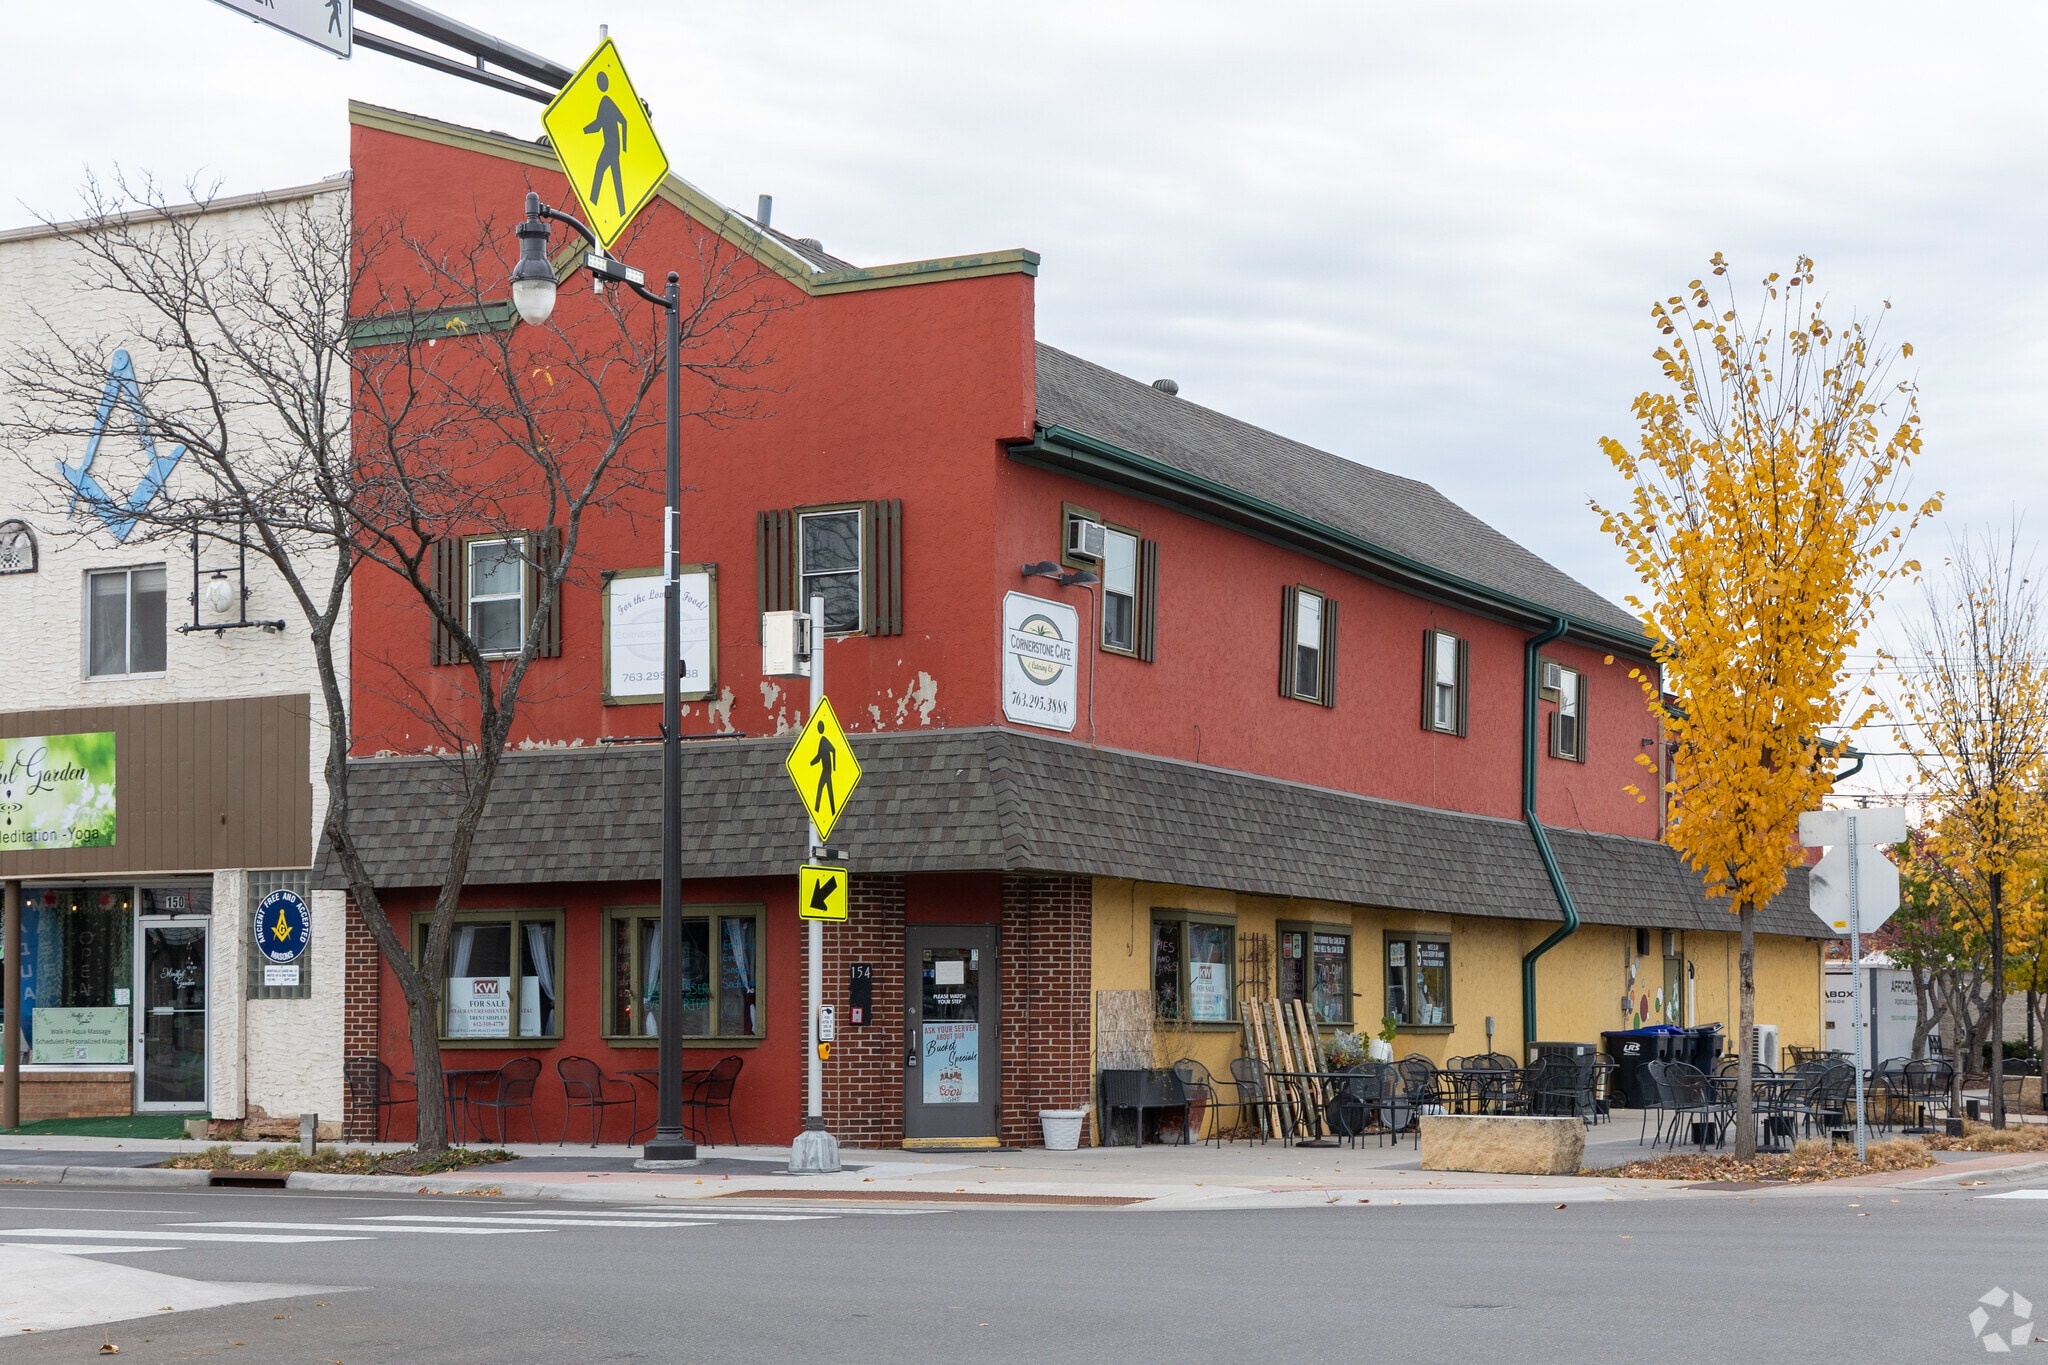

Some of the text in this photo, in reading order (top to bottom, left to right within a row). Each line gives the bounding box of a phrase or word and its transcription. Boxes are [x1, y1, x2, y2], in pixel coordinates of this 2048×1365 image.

[617, 589, 665, 615] For the Lov
[682, 592, 708, 611] Food!
[1011, 634, 1071, 661] CORNERSTONE CAFE
[1012, 691, 1068, 715] 763.295.3888
[16, 747, 88, 796] Garden
[0, 829, 57, 843] editation
[167, 896, 184, 908] 150
[257, 892, 309, 943] ANCIENT FREE AND ACCEPTED
[1156, 941, 1175, 953] PIES
[270, 950, 294, 961] MASONS
[1157, 955, 1171, 963] AND
[851, 965, 871, 979] 154
[1200, 967, 1211, 979] KW
[474, 982, 498, 993] KW
[87, 1028, 111, 1036] Massage
[924, 1024, 977, 1035] ASK YOUR SERVER
[102, 1038, 126, 1046] Massage
[954, 1032, 965, 1040] OUR
[925, 1039, 957, 1058] Bucket
[1623, 1043, 1640, 1051] LRS
[948, 1051, 978, 1067] Specials
